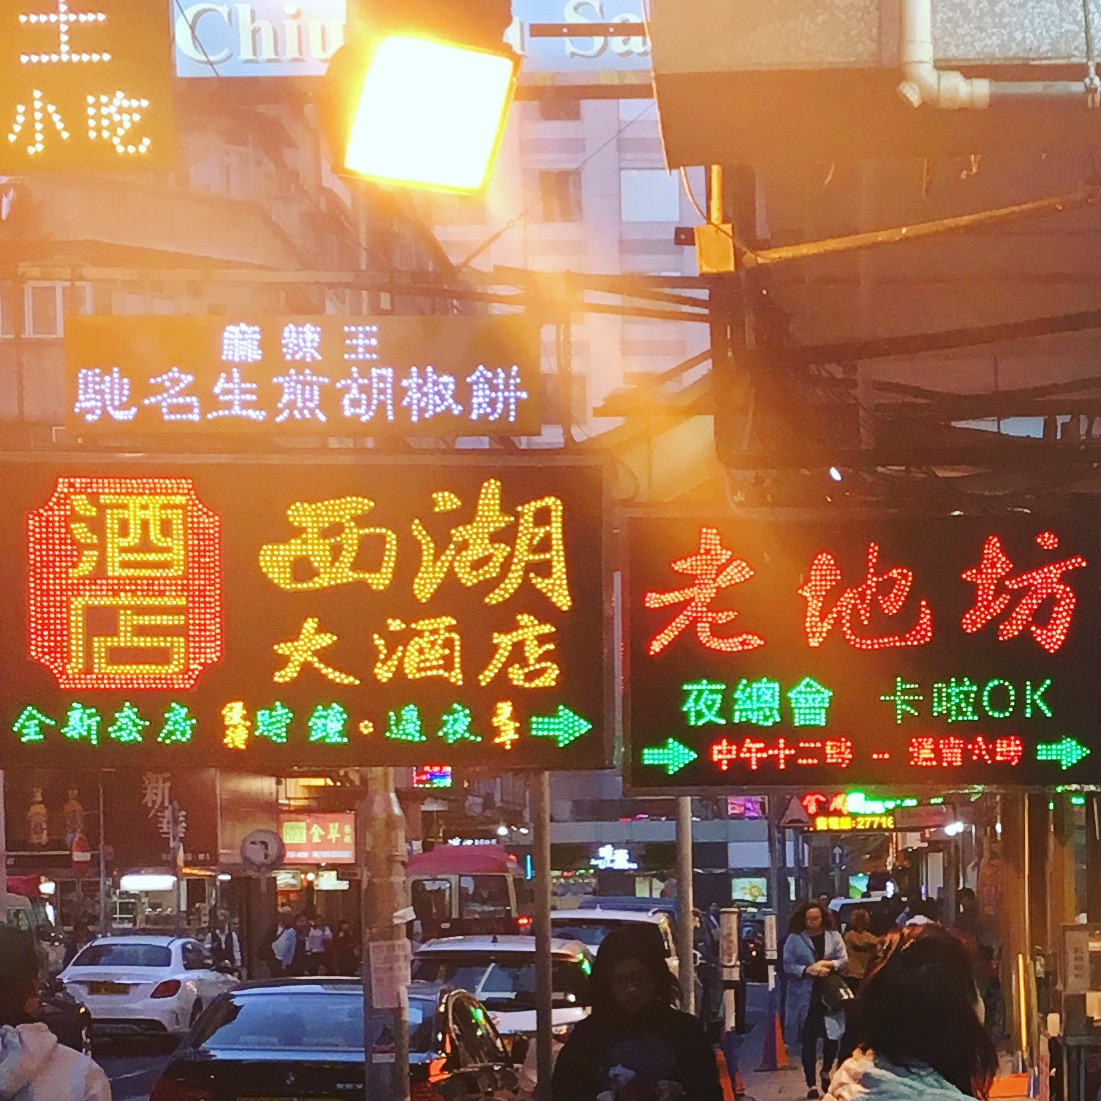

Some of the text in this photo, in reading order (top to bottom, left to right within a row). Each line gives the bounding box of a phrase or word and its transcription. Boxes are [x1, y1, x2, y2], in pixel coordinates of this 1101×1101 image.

[8, 89, 151, 155] 小吃
[73, 366, 528, 423] 馳名生煎胡椒餅
[258, 478, 573, 612] 西湖
[644, 526, 1088, 656] 老地坊
[272, 614, 560, 687] 大酒店
[681, 676, 834, 727] 夜總會
[711, 737, 853, 771] 中午十二時
